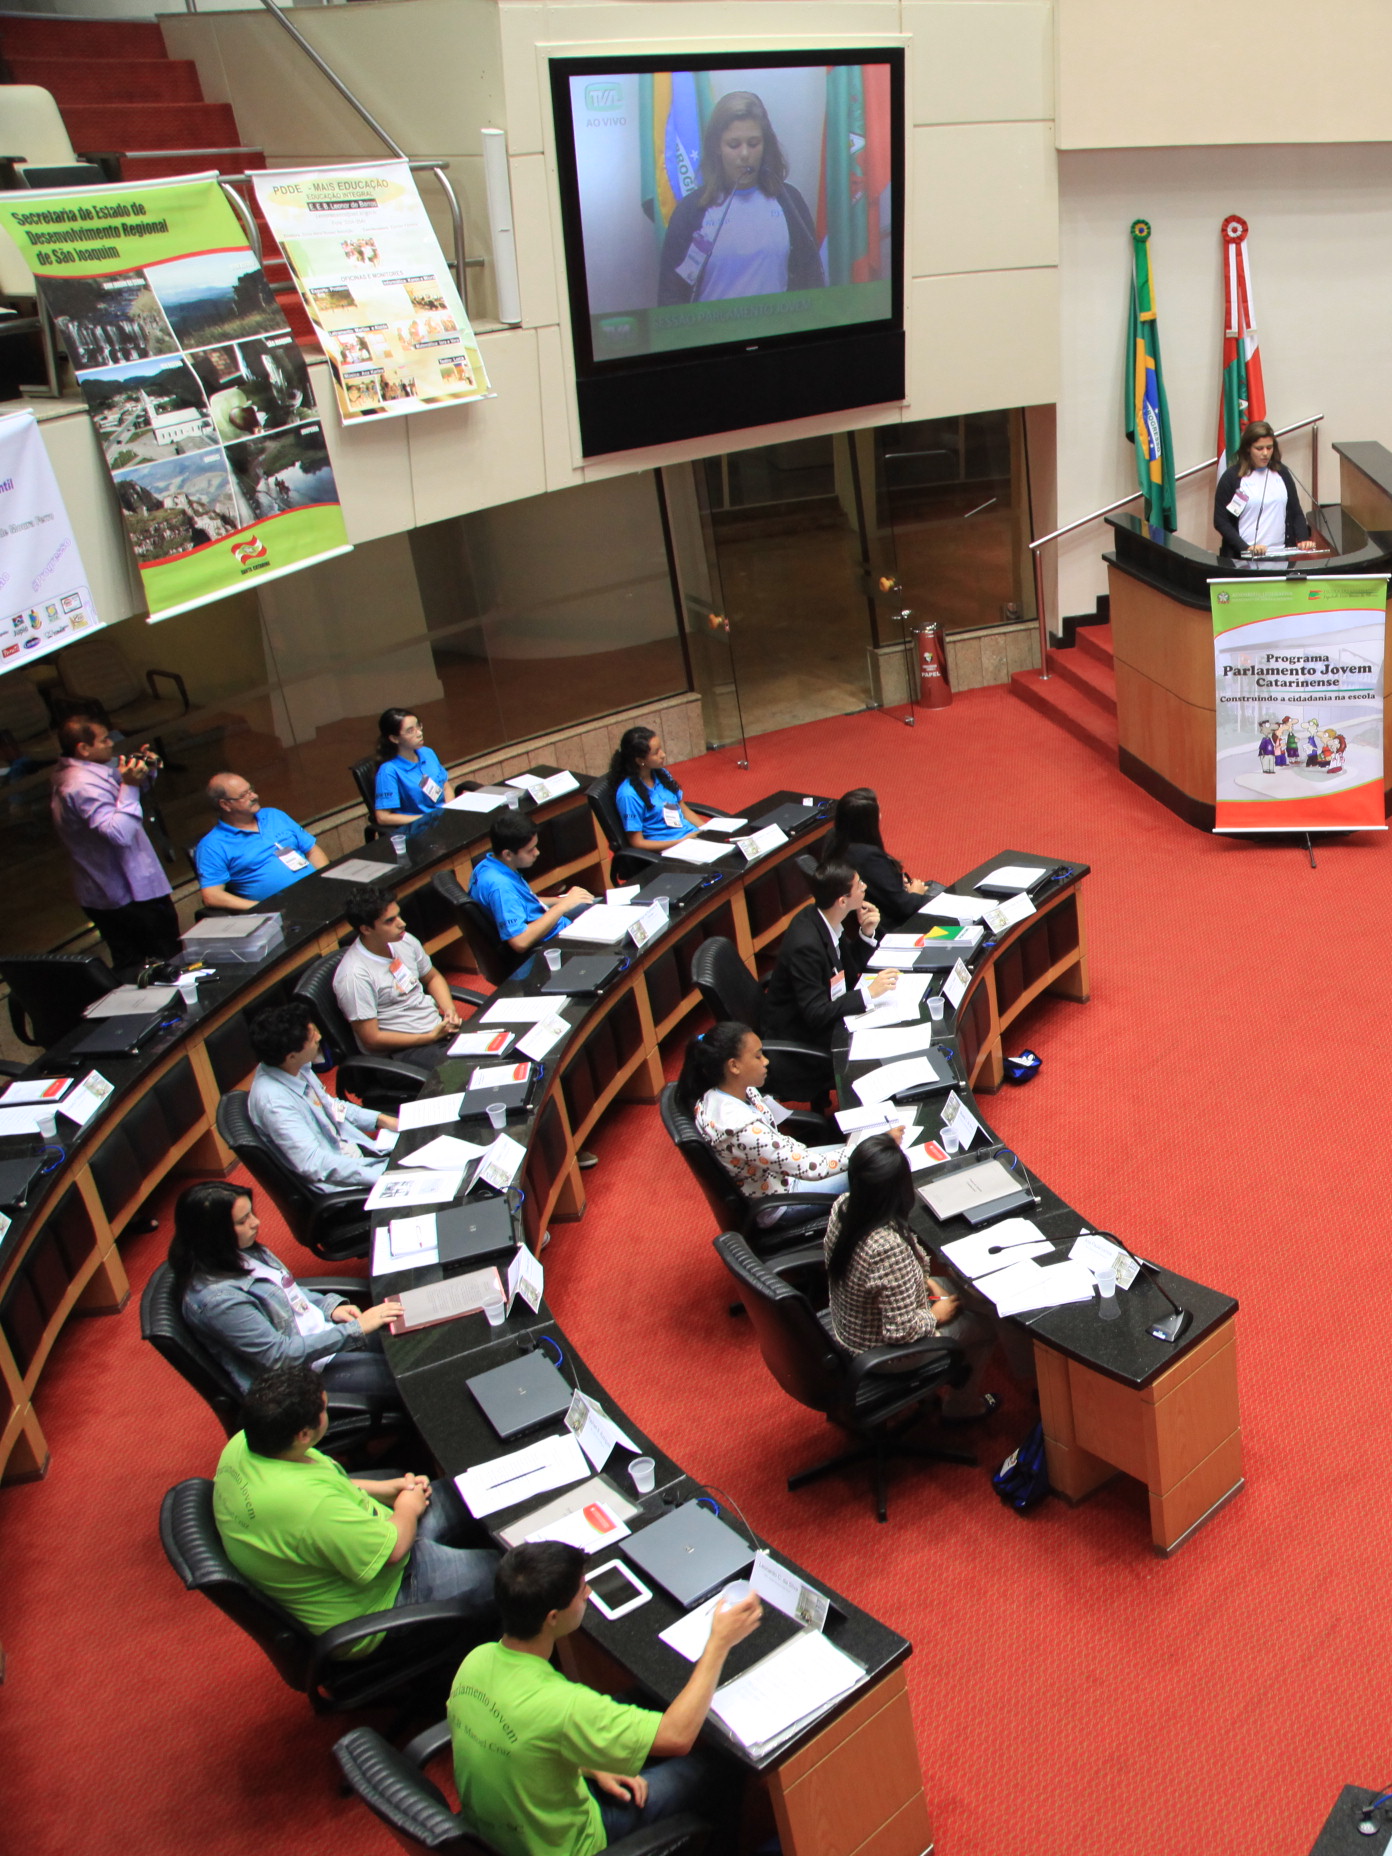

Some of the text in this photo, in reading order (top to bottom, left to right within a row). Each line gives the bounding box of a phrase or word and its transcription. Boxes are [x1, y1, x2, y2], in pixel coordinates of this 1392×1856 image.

[586, 116, 627, 128] AO VIVO
[272, 184, 303, 196] PDDE
[312, 182, 336, 192] MAIS
[337, 178, 389, 191] EDUCAÇÃO
[11, 201, 147, 226] Secretaria de Estado de
[25, 218, 169, 246] Desenvolvimento Regional
[36, 245, 121, 266] de São Joaquim
[1266, 653, 1330, 665] Programa
[1223, 663, 1373, 677] Parlamento Jovem
[1256, 677, 1340, 688] Catarinense
[1220, 694, 1279, 703] Construindo
[1287, 694, 1332, 703] cidadania
[1347, 693, 1376, 701] escola
[489, 1702, 519, 1744] Jovem
